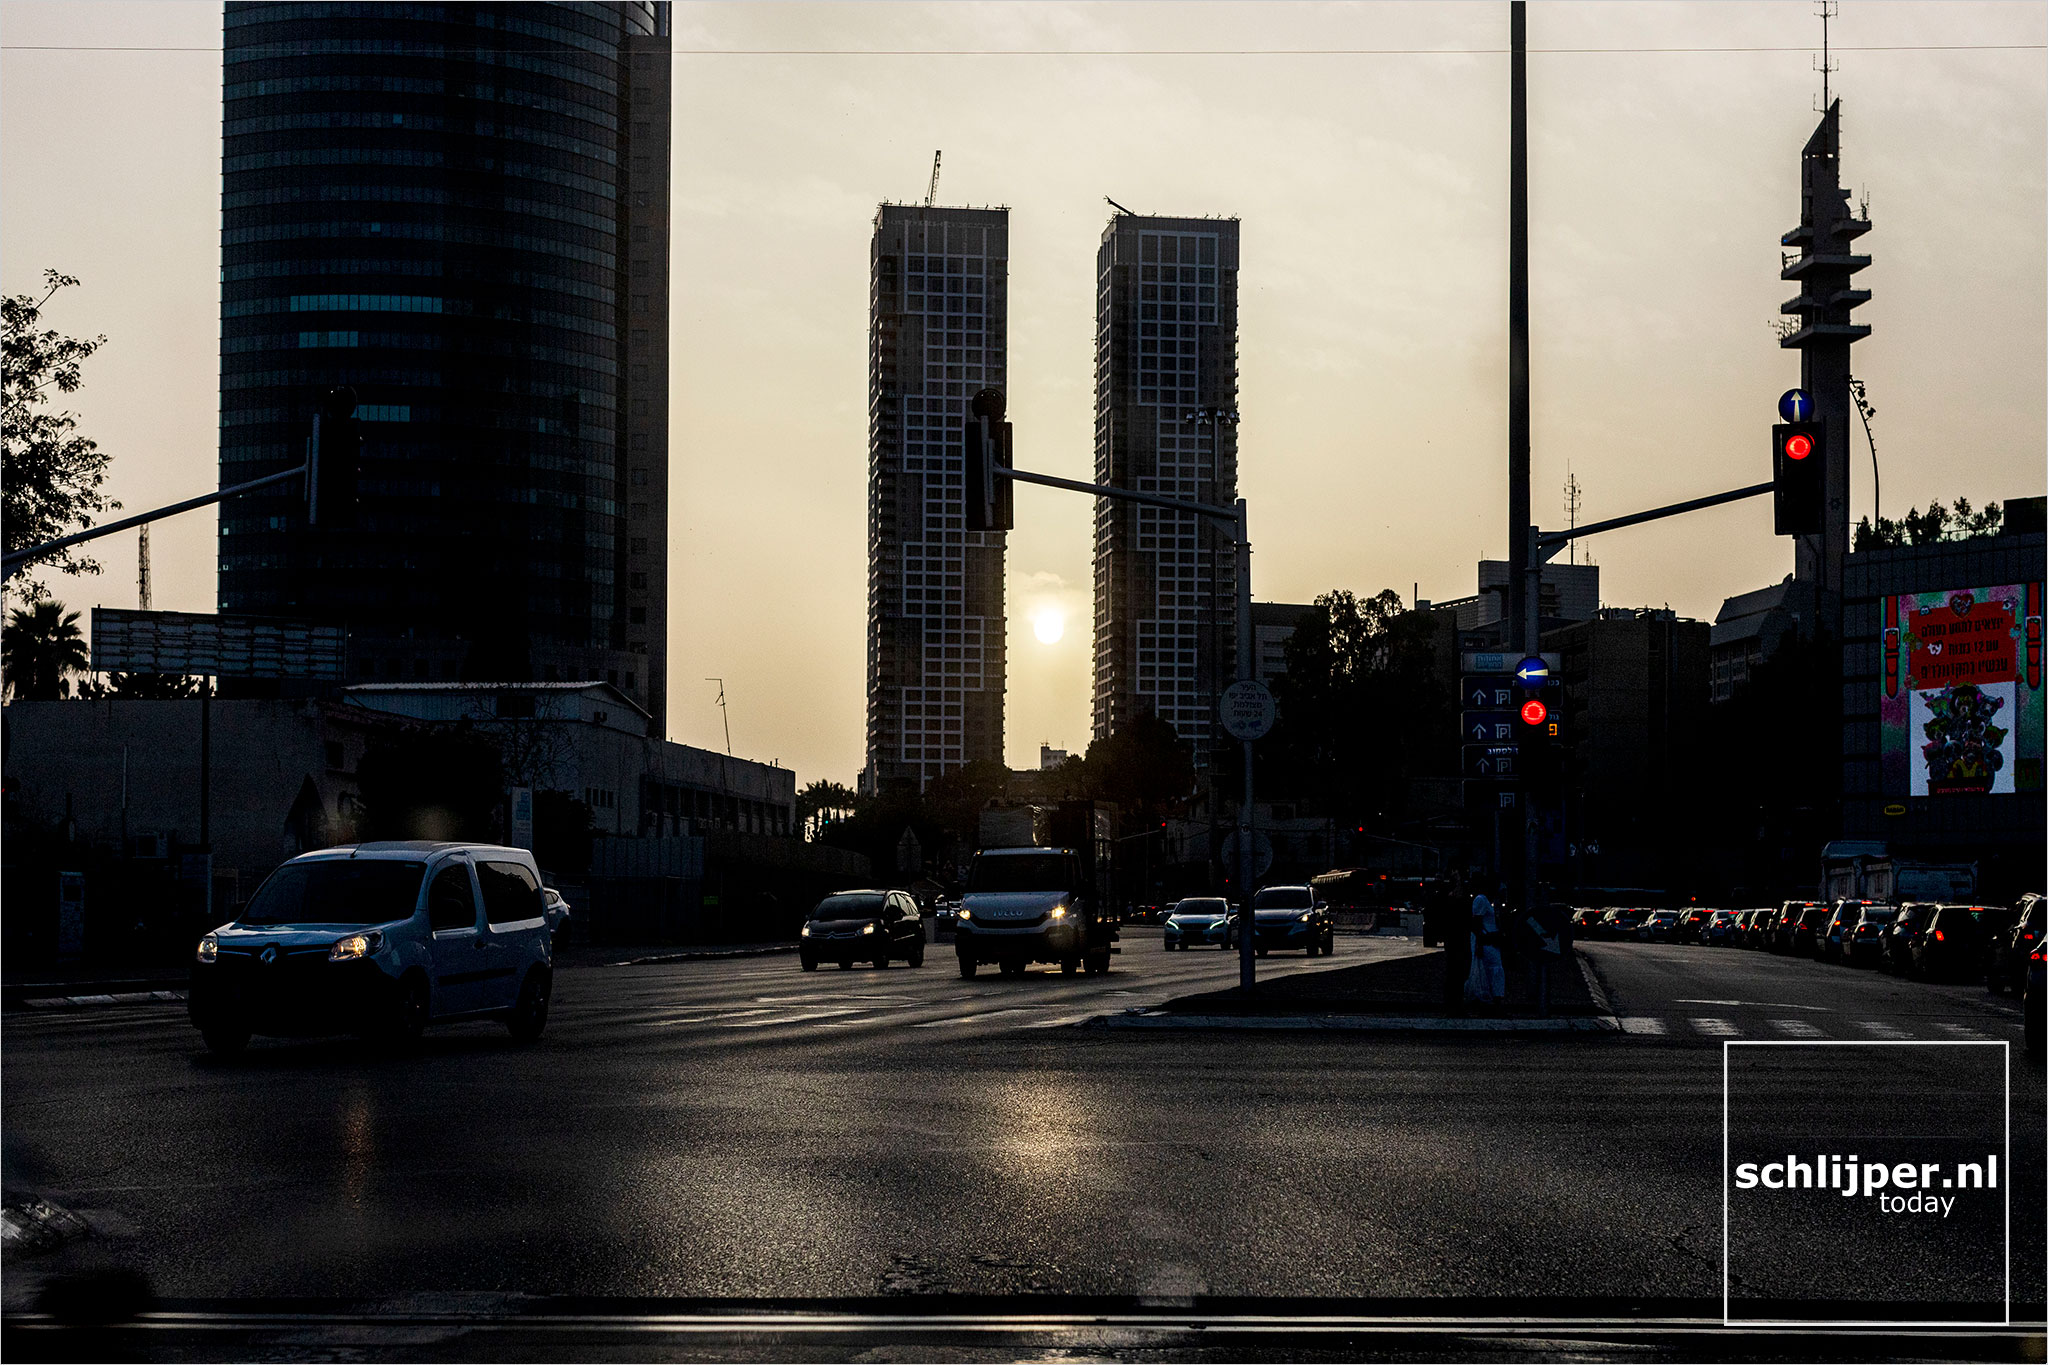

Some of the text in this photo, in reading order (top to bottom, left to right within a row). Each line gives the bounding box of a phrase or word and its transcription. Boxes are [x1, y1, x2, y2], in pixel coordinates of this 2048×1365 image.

[1921, 624, 1946, 637] בעולם
[1975, 618, 2003, 631] יוצאים
[1927, 639, 1944, 656] ty
[1974, 641, 1983, 653] 12
[1986, 640, 1998, 651] עם
[1978, 658, 2007, 672] עכשיו
[1240, 692, 1256, 700] אביב
[1257, 692, 1267, 700] תל
[992, 910, 1024, 918] IVECO
